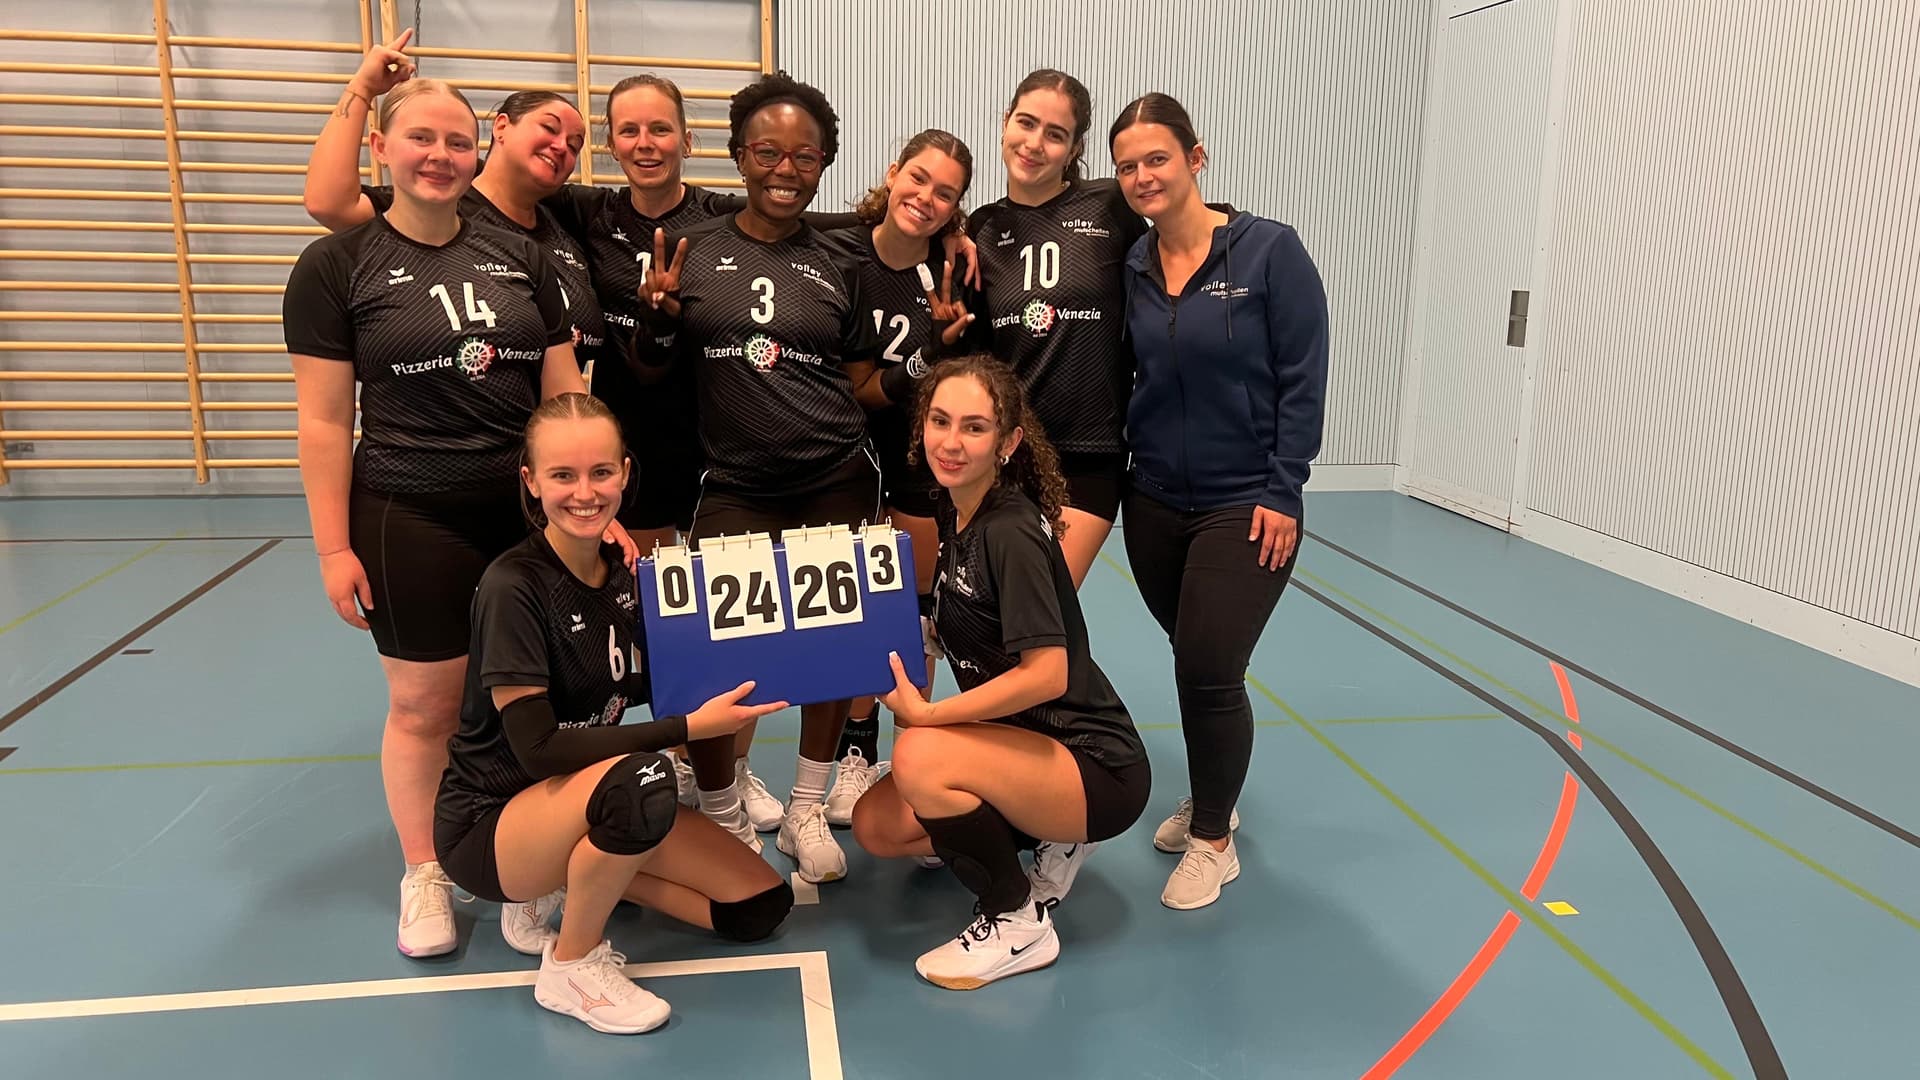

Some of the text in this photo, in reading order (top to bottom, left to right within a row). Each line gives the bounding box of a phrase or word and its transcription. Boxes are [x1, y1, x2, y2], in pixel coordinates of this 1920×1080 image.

[1062, 219, 1093, 228] volley
[791, 262, 822, 278] volley
[1019, 241, 1060, 291] 10
[428, 282, 497, 331] 14
[750, 277, 775, 324] 3
[1056, 308, 1101, 320] Venezia
[391, 355, 453, 377] Pizzeria
[704, 345, 742, 359] Pizzeria
[870, 544, 895, 585] 3
[662, 565, 689, 608] 0
[711, 571, 778, 630] 24
[794, 560, 858, 619] 26
[608, 624, 626, 682] 6
